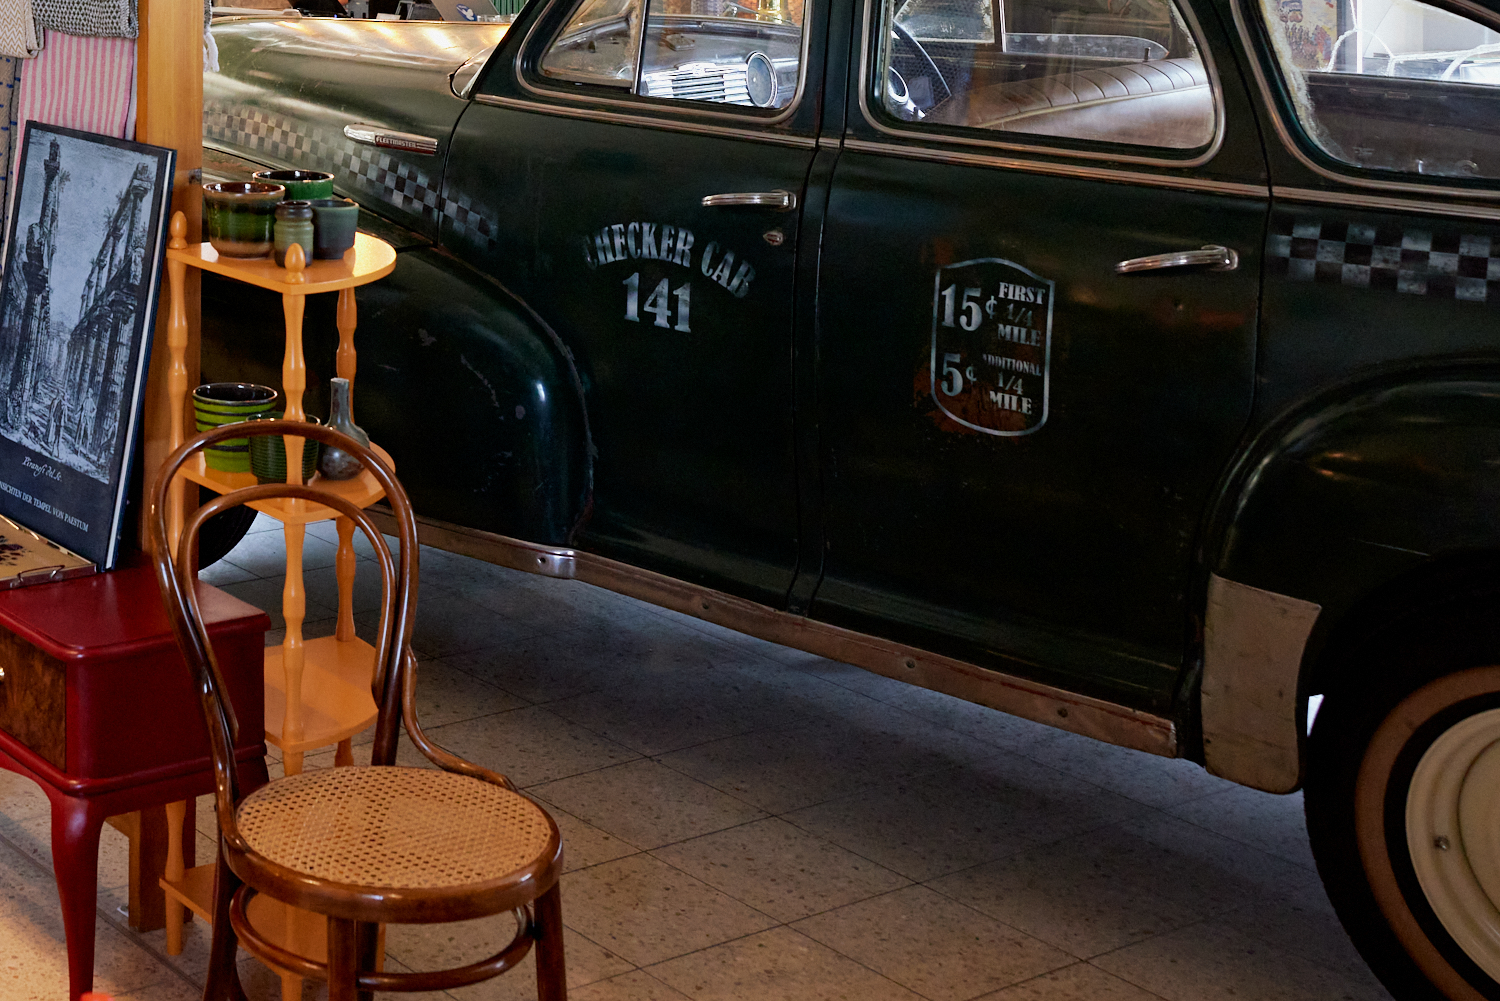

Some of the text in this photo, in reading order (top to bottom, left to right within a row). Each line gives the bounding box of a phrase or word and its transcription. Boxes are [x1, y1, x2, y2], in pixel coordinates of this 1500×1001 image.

[375, 135, 418, 149] FLEETMASTER
[583, 221, 756, 299] CHECKER CAB
[622, 271, 692, 334] 141
[998, 281, 1046, 305] FIRST
[1006, 303, 1033, 327] 1/4
[997, 323, 1042, 347] MILE
[989, 390, 1033, 415] MILE
[21, 492, 33, 505] DER
[33, 497, 52, 514] TEMPEL
[52, 507, 64, 520] VON
[63, 512, 89, 533] PAESTUM
